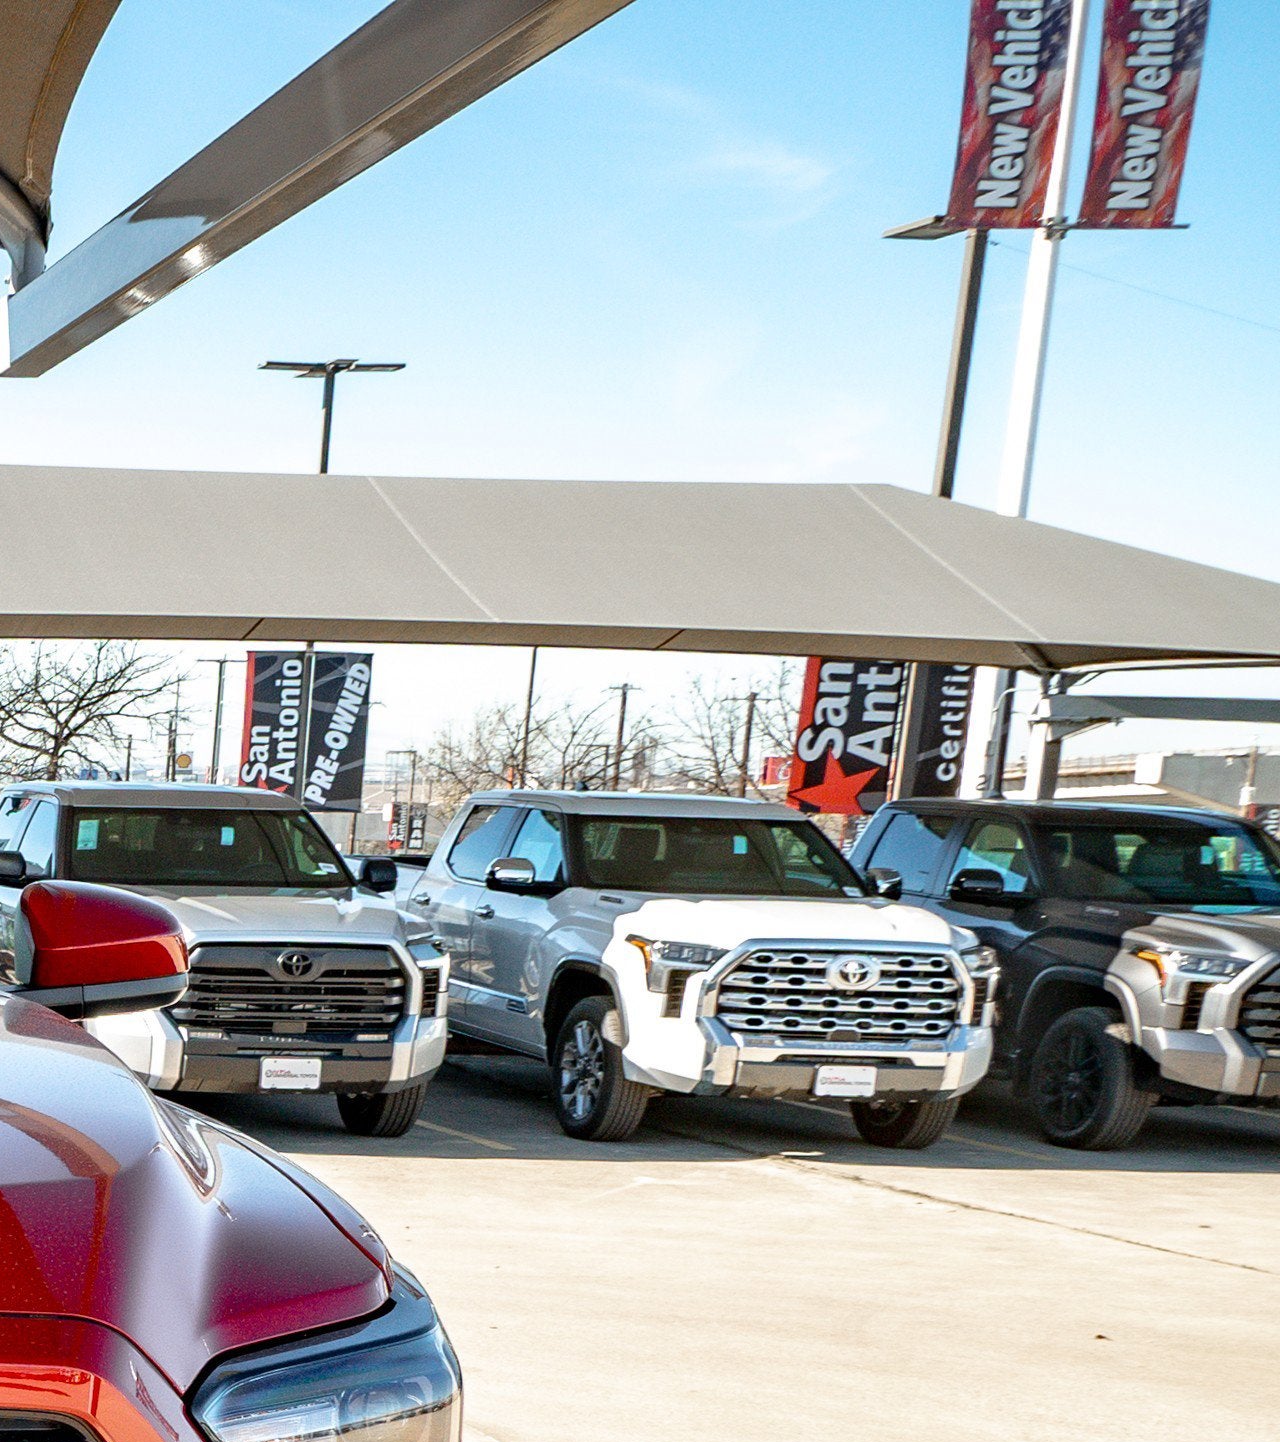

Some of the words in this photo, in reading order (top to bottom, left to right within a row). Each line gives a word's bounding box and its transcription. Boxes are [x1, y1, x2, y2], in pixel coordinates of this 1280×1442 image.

[974, 122, 1030, 208] New
[1106, 123, 1162, 210] New
[240, 725, 272, 784] San
[268, 659, 303, 785] Antonio
[304, 662, 371, 806] PRE-OWNED
[798, 662, 856, 762] San
[846, 661, 902, 767] Ant
[409, 819, 424, 848] RAM
